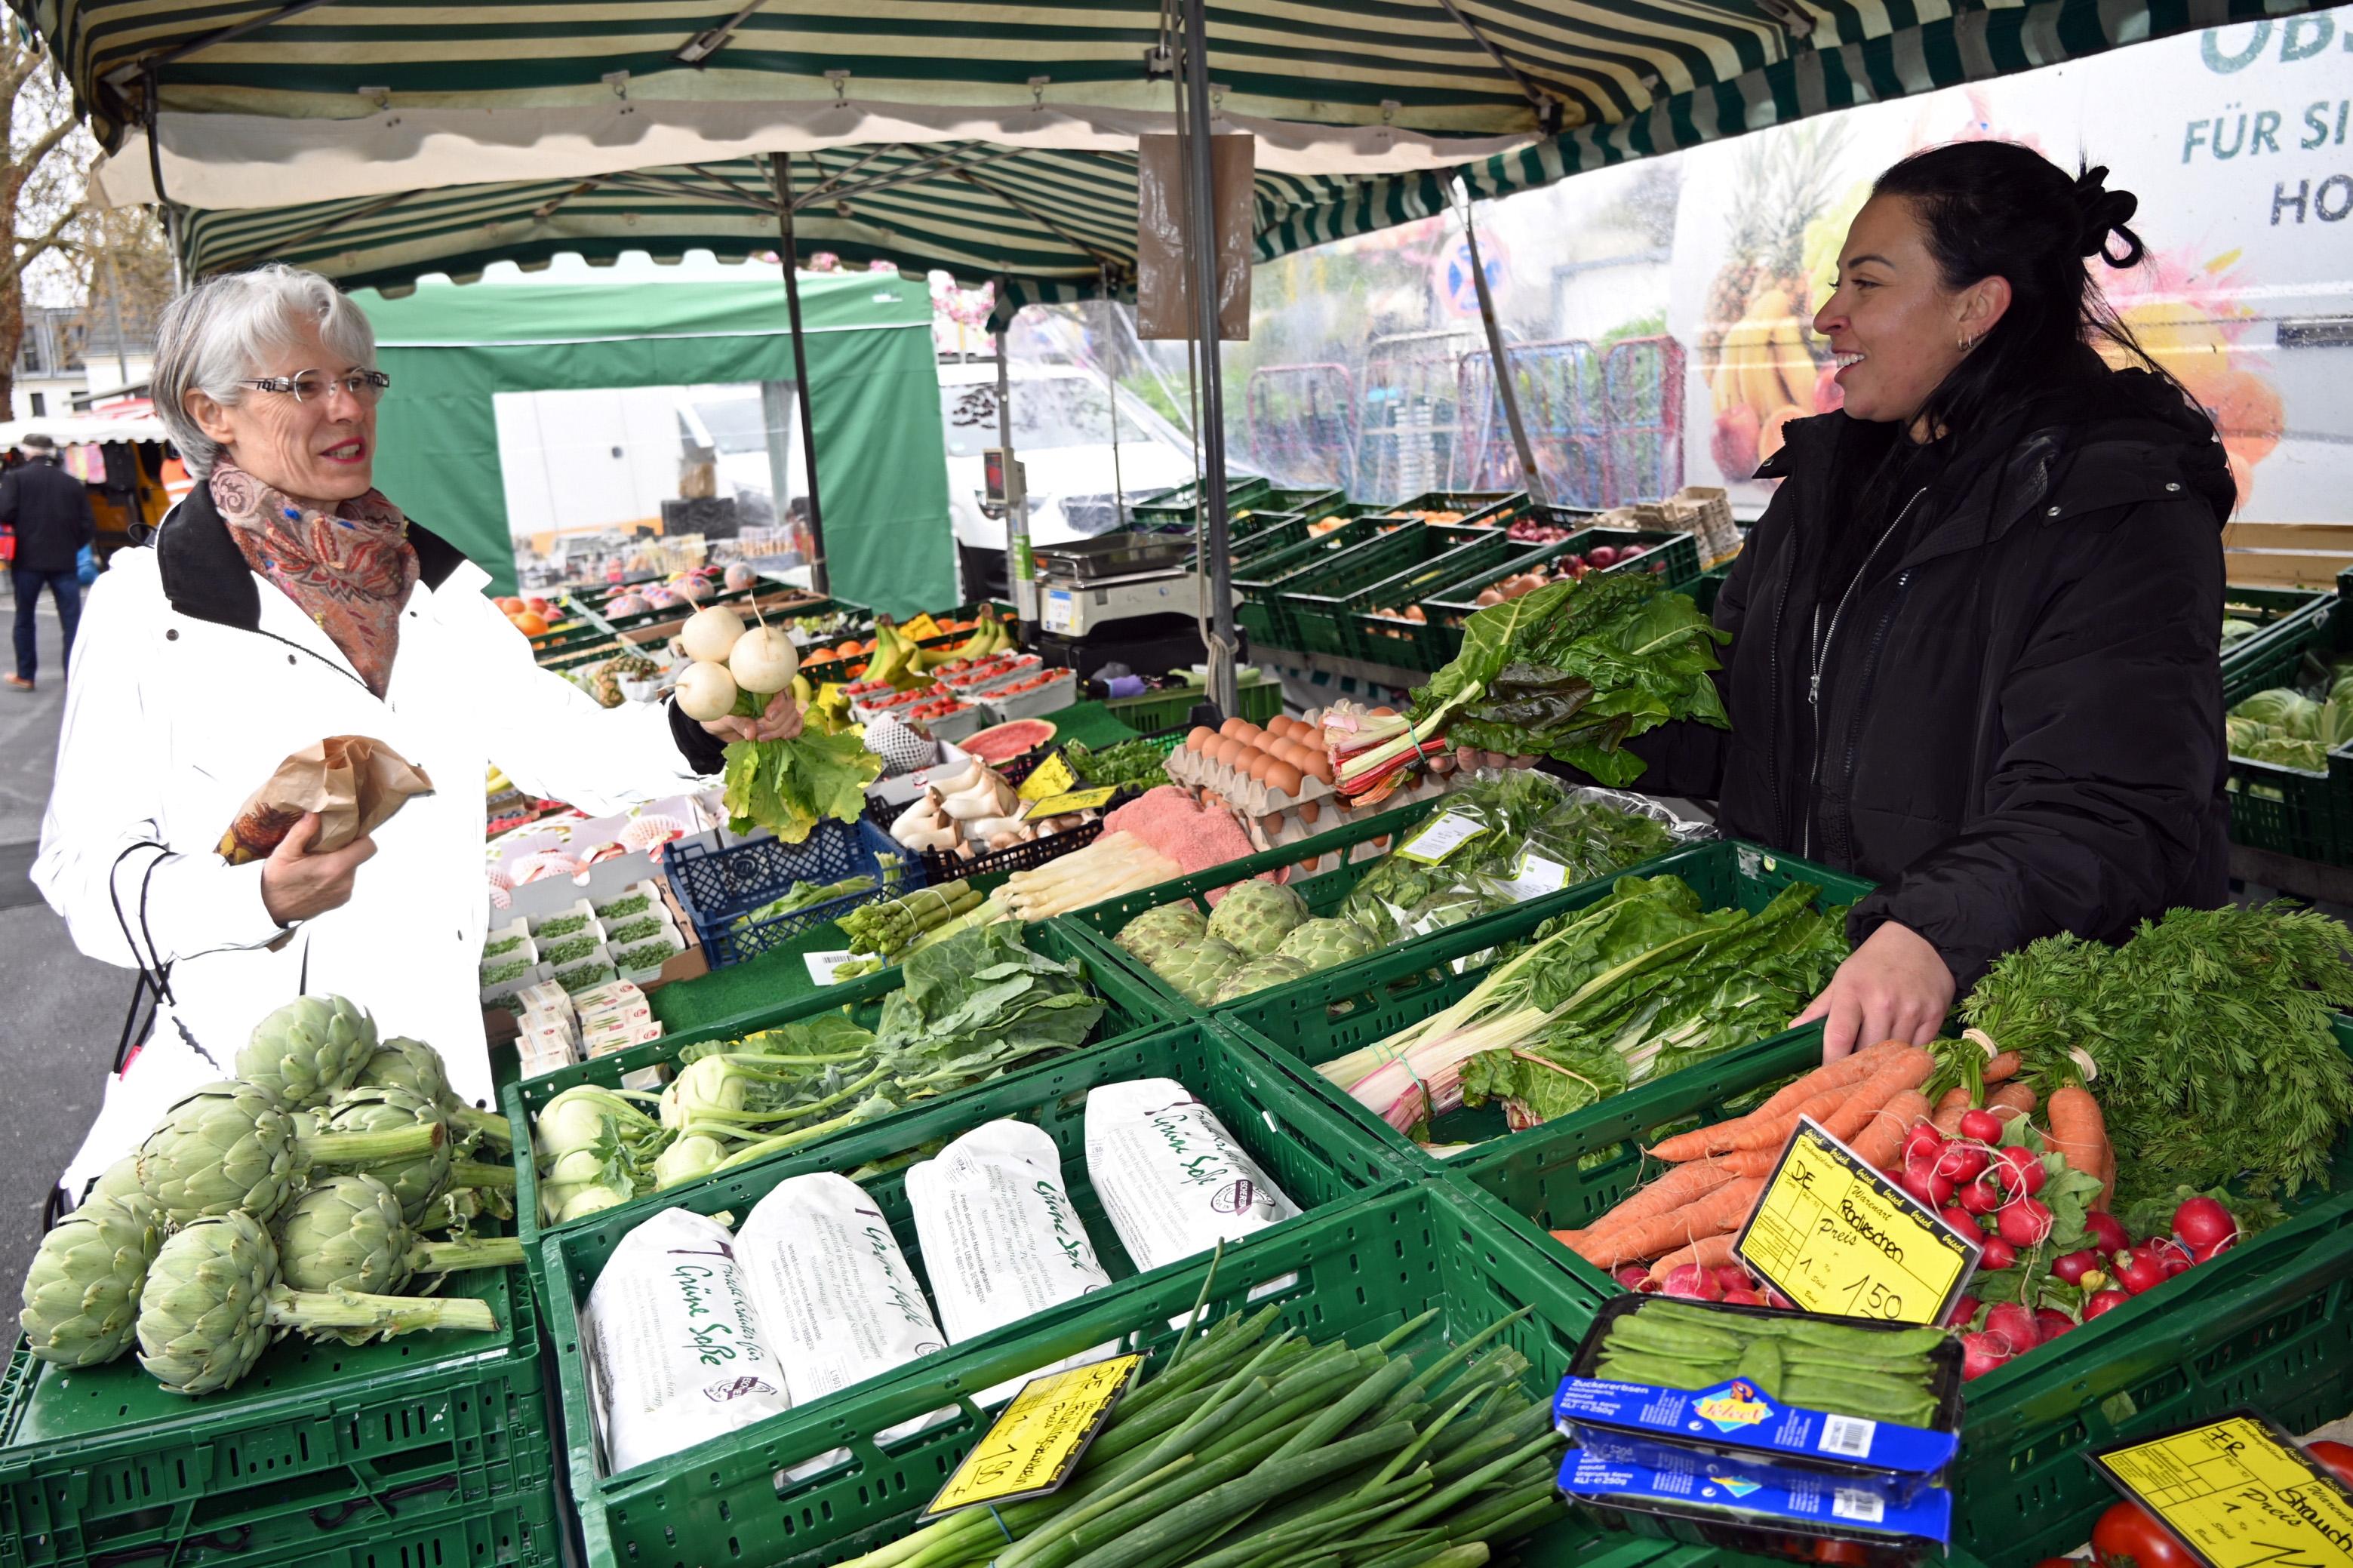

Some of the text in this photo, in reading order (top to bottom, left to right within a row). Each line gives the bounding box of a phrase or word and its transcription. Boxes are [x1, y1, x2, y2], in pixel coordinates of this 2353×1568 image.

[2182, 102, 2281, 164] FÜR
[1791, 1160, 1816, 1190] DE
[1851, 1185, 1893, 1221] Warenart
[968, 1225, 977, 1241] Lydia
[1817, 1218, 1857, 1246] Preis
[1841, 1199, 1904, 1264] Radieschen
[1800, 1258, 1813, 1274] 1
[669, 1265, 737, 1366] Grüne Soße
[829, 1370, 842, 1389] L1603
[1084, 1367, 1115, 1391] DE
[1571, 1379, 1649, 1394] Zuckererbsen
[1044, 1402, 1066, 1429] Preis
[2210, 1426, 2246, 1458] FR
[2237, 1487, 2302, 1527] Preis
